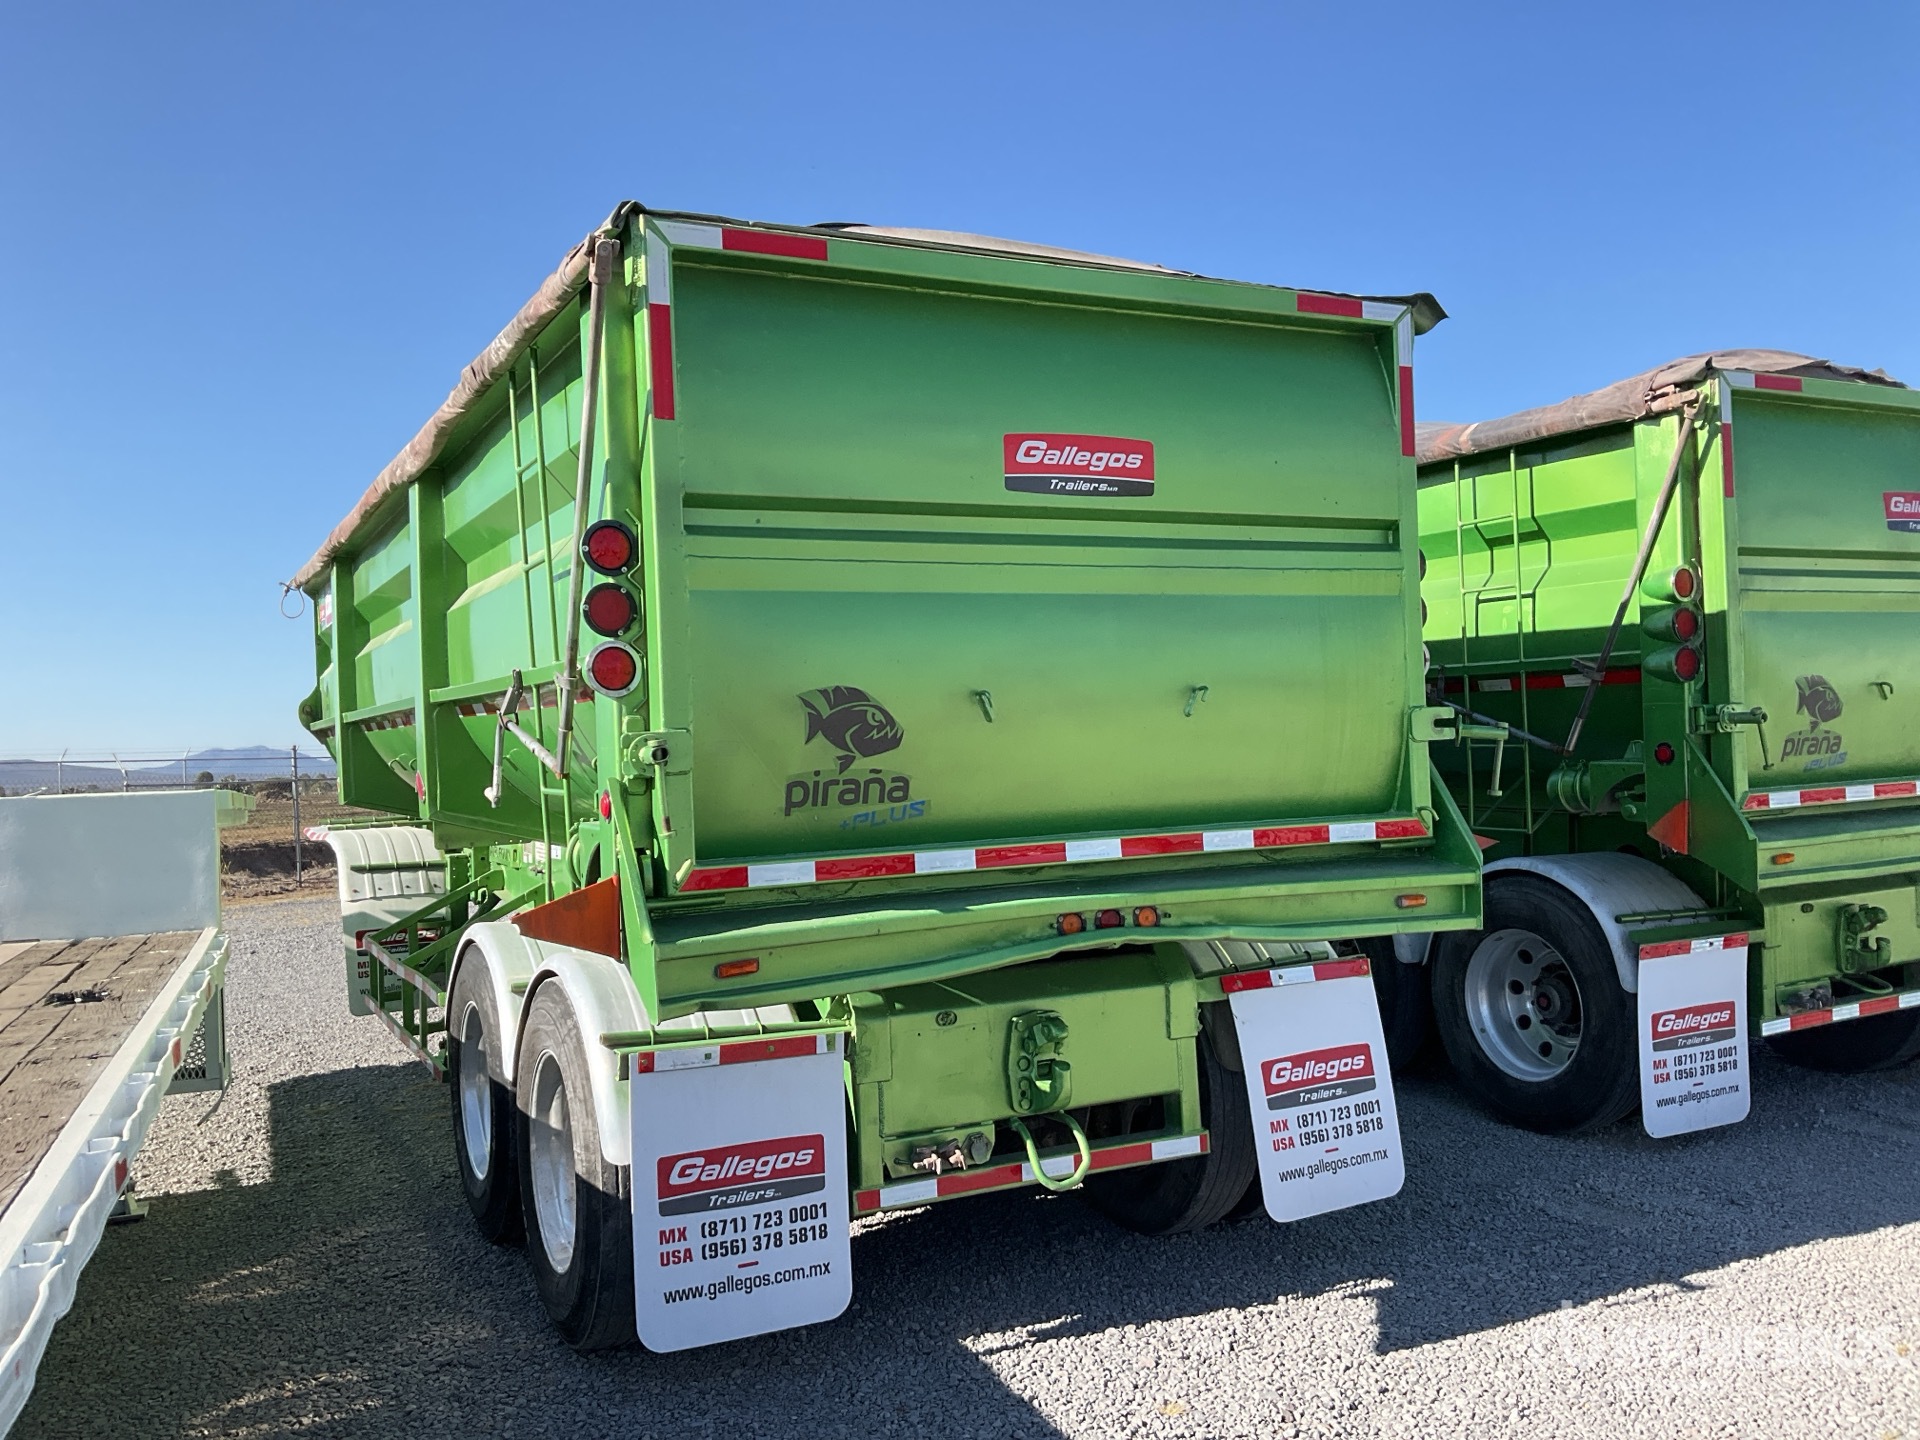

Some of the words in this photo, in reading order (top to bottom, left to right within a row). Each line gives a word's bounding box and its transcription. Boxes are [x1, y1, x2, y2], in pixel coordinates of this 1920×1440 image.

[1015, 440, 1144, 471] Gallegos
[1050, 479, 1108, 492] Trailers
[1891, 496, 1920, 513] Gall
[1781, 729, 1842, 762] piraña
[784, 768, 910, 816] piraña
[1657, 1008, 1731, 1032] Gallegos
[1677, 1035, 1711, 1047] Trailers
[1270, 1053, 1366, 1085] Gallegos
[1653, 1058, 1668, 1071] MX
[1673, 1052, 1697, 1068] (871)
[1699, 1049, 1715, 1063] 723
[1717, 1045, 1738, 1059] 0001
[1653, 1071, 1671, 1084] USA
[1674, 1066, 1698, 1081] (956)
[1699, 1063, 1715, 1077] 378
[1717, 1059, 1738, 1073] 5818
[1299, 1087, 1343, 1103] Trailers
[1656, 1084, 1740, 1108] www.gallegos.com.mx
[1270, 1118, 1289, 1134] MX
[1296, 1109, 1328, 1129] (871)
[1330, 1104, 1351, 1122] 723
[1353, 1099, 1381, 1118] 0001
[1272, 1136, 1295, 1152] USA
[1299, 1127, 1330, 1147] (956)
[1333, 1122, 1353, 1140] 378
[1356, 1116, 1384, 1135] 5818
[668, 1147, 815, 1185] Gallegos
[1278, 1148, 1389, 1183] www.gallegos.com.mx
[708, 1188, 775, 1207] Trailers
[658, 1226, 688, 1246] MX
[700, 1215, 747, 1239] (871)
[752, 1209, 783, 1231] 723
[788, 1202, 828, 1224] 0001
[659, 1247, 693, 1267] USA
[701, 1237, 747, 1260] (956)
[752, 1229, 783, 1252] 378
[788, 1223, 829, 1245] 5818
[663, 1261, 831, 1304] www.gallegos.com.mx
